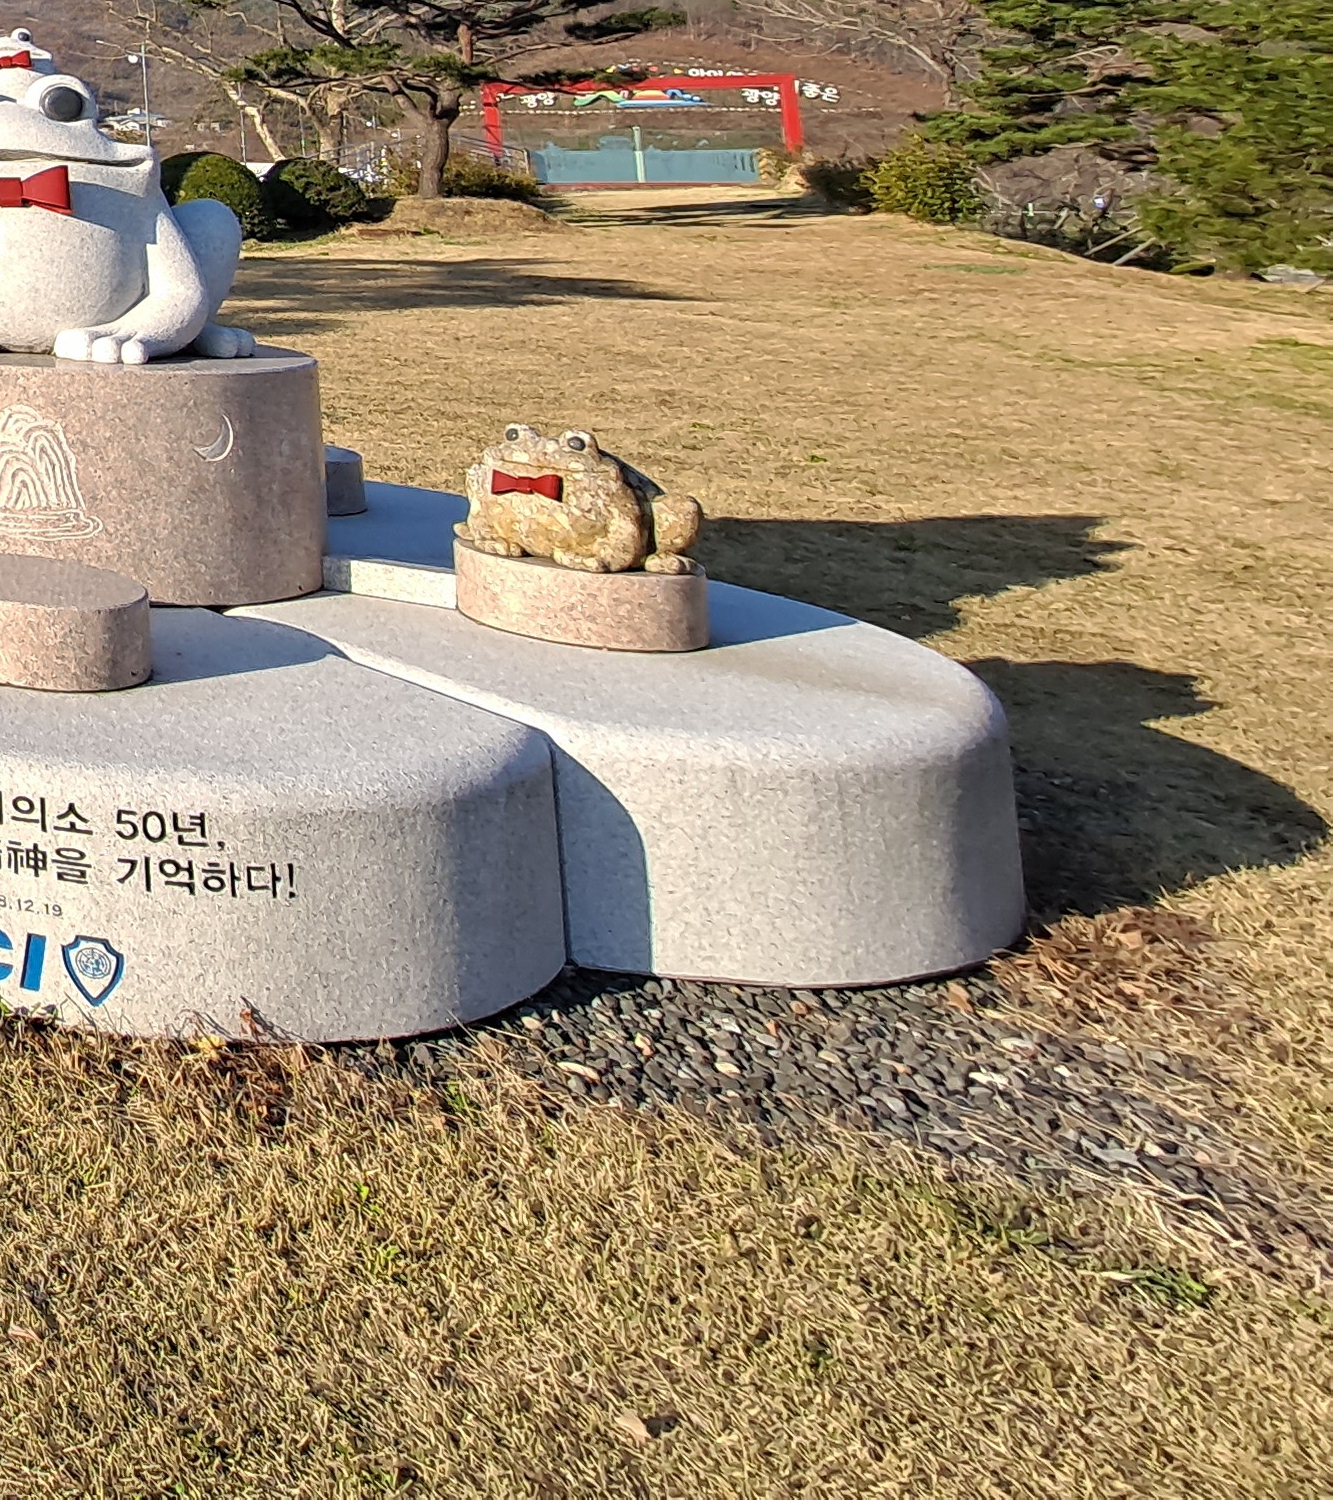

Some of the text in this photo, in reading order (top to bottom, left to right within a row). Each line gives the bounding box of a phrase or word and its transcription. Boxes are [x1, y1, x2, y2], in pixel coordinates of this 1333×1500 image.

[801, 82, 842, 103] 좋은
[114, 809, 227, 851] 50년,
[115, 857, 299, 900] 기억하다!
